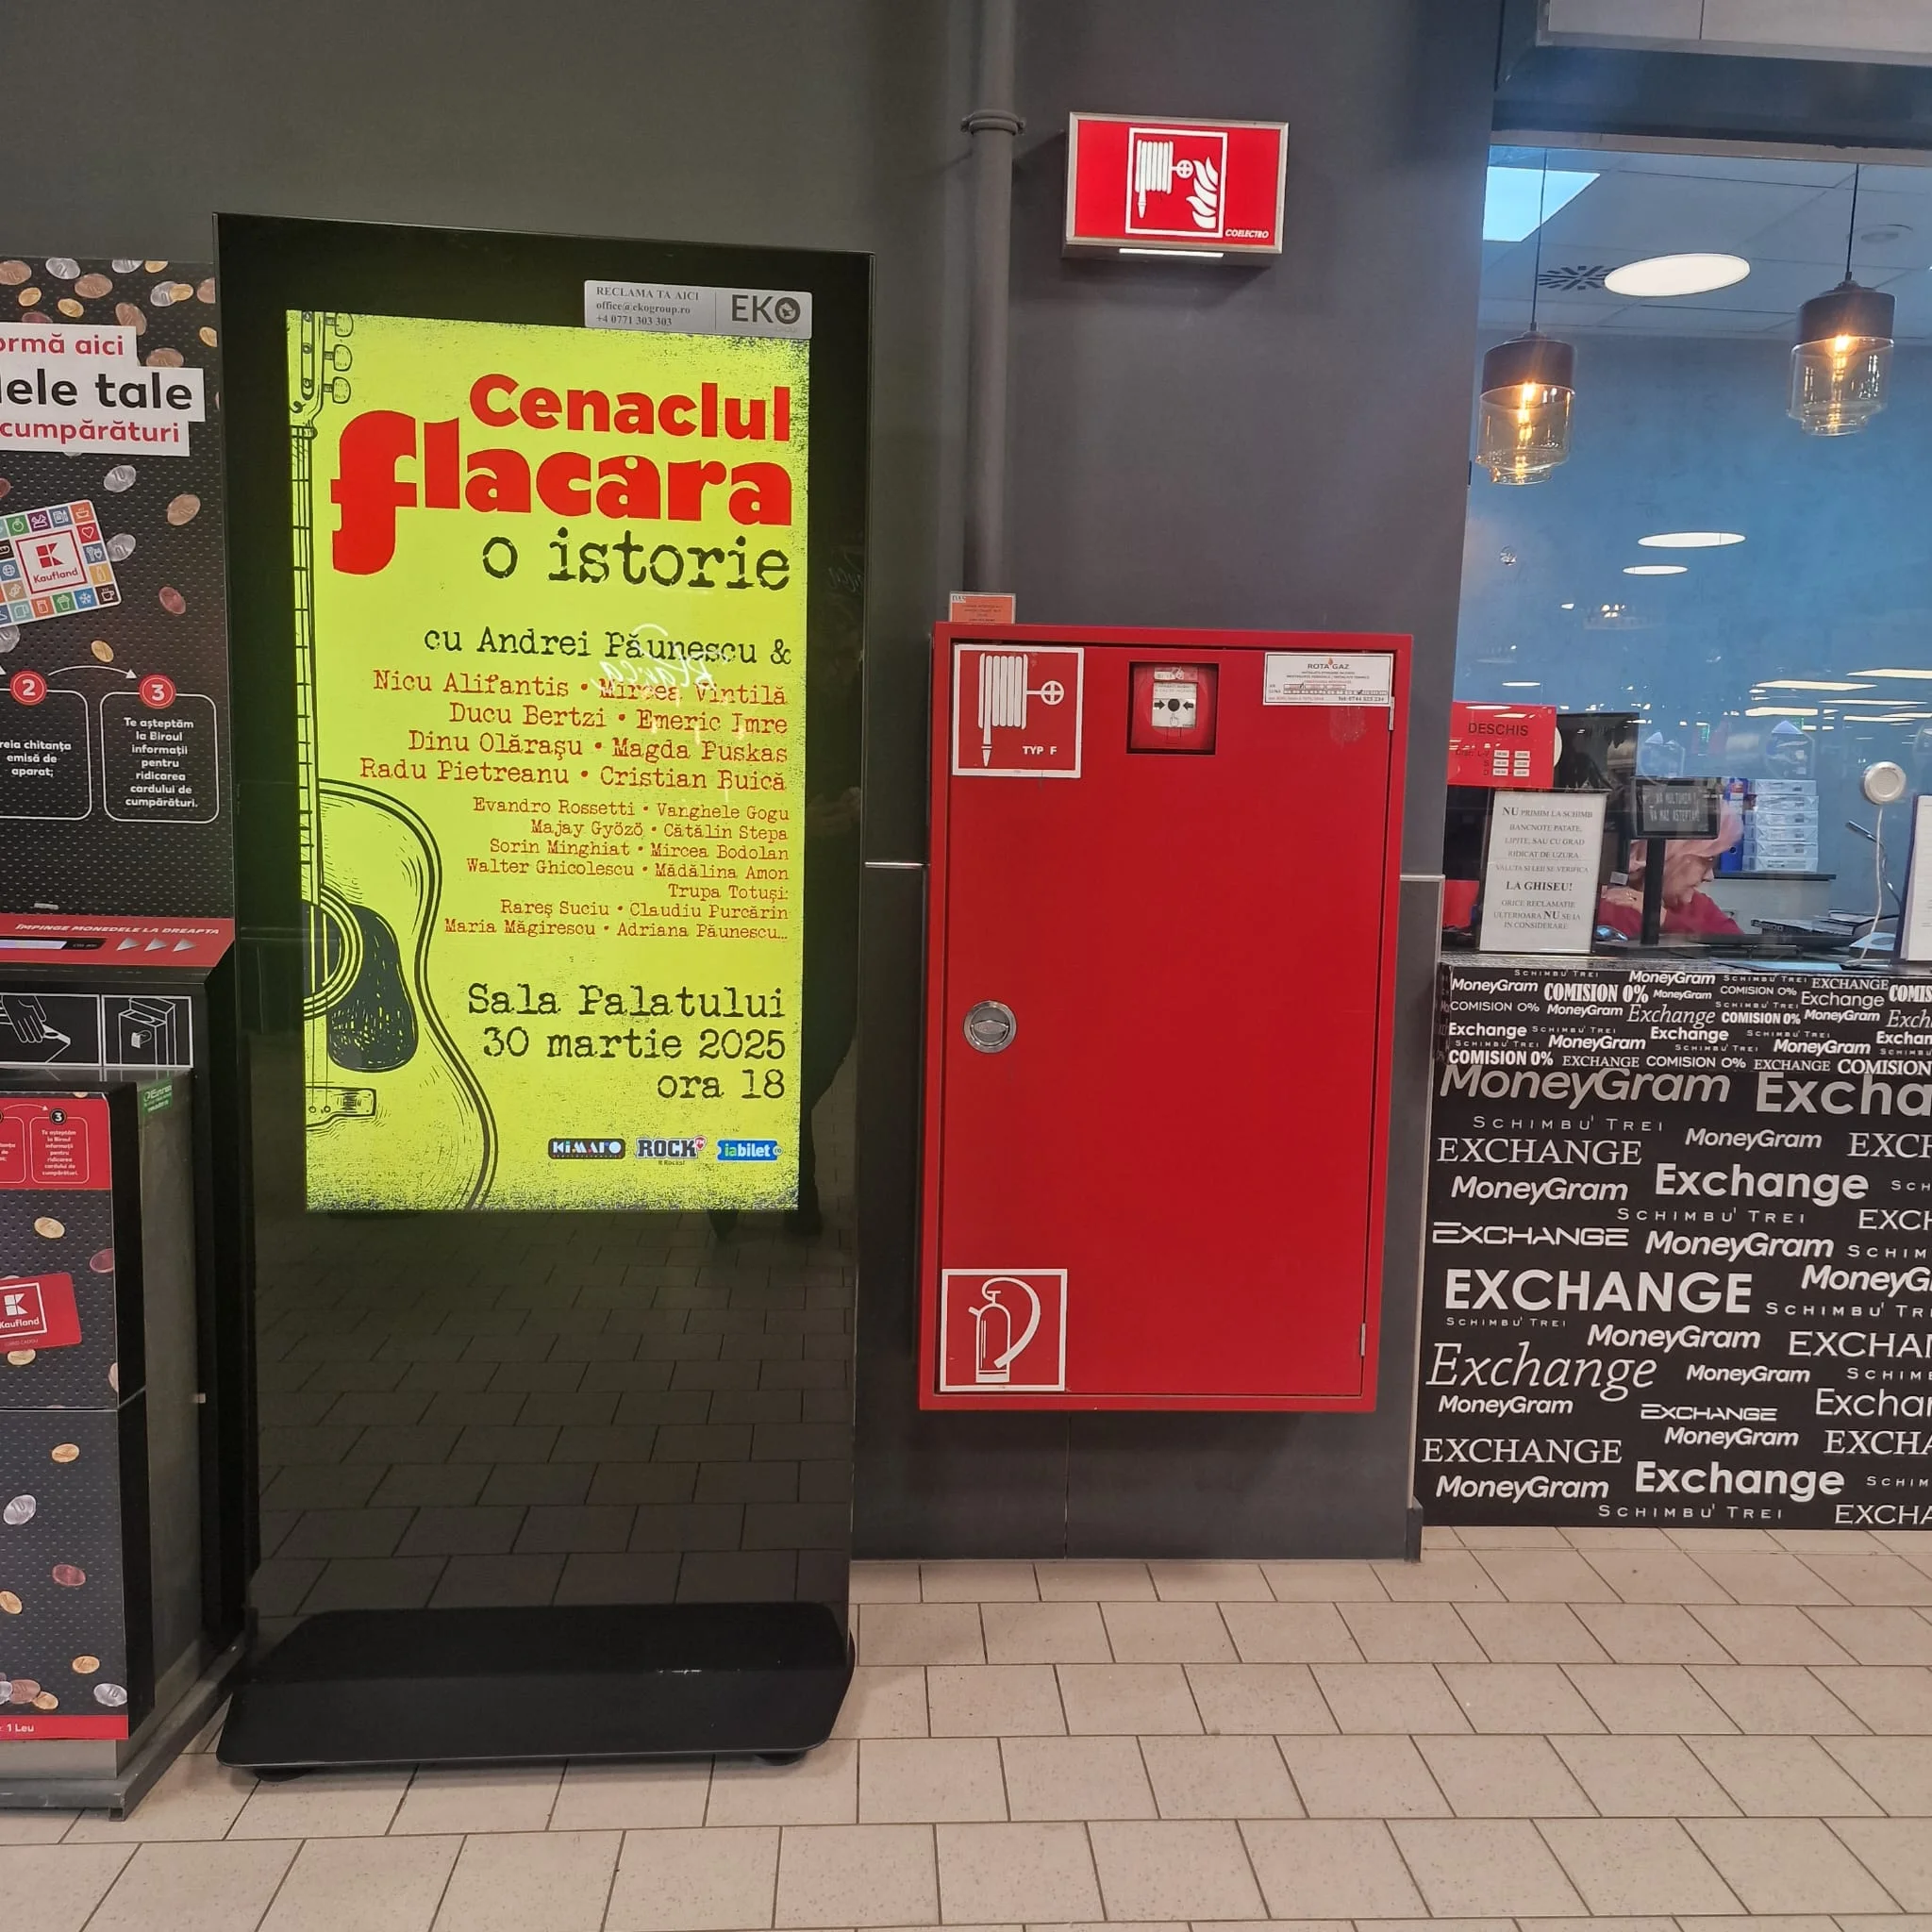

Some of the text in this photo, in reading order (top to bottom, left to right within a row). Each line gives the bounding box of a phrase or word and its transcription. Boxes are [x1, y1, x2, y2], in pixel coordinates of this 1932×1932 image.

[1224, 228, 1269, 239] COELECTRO
[596, 286, 699, 301] RECLAMA TA AICI
[596, 302, 691, 315] office@ekogroup.ro
[731, 293, 801, 325] EKO
[610, 316, 632, 325] 0771
[636, 317, 653, 326] 303
[656, 318, 673, 326] 303
[75, 335, 124, 356] aici
[0, 368, 192, 409] ele tale
[470, 374, 791, 441] Cenaclul
[0, 419, 179, 444] cumpărături
[330, 409, 792, 575] flacara
[482, 536, 518, 578] o
[548, 526, 791, 590] istorie
[33, 567, 78, 584] Kaufland
[424, 626, 791, 664] cu Andrei Păunescu &
[22, 678, 36, 696] 2
[151, 684, 165, 701] 3
[373, 669, 787, 705] Nicu Alifantis Mircea Vintilă
[124, 717, 194, 731] Te așteptăm
[449, 702, 788, 734] Ducu Bertzi Emeric Imre
[136, 731, 183, 742] la Biroul
[1468, 723, 1528, 737] DESCHIS
[24, 740, 72, 752] chitanța
[132, 744, 188, 757] informații
[408, 729, 788, 762] Dinu Olărașu Magda Puskas
[1023, 745, 1058, 756] TYP F
[7, 753, 58, 763] emisă de
[142, 758, 180, 771] pentru
[11, 767, 54, 778] aparat;
[136, 772, 186, 783] ridicarea
[360, 757, 786, 791] Radu Pietreanu Cristian Buică
[130, 785, 192, 796] cardului de
[125, 797, 199, 810] cumpărături.
[473, 797, 790, 822] Evandro Rossetti Vanghele Gogu
[1502, 807, 1520, 816] NU
[1521, 809, 1550, 818] PRIMIM
[1562, 810, 1593, 819] SCHIMB
[531, 819, 584, 837] Majay
[663, 824, 732, 840] Cătălin
[739, 826, 788, 843] Stepa
[490, 839, 789, 860] Sorin Minghiat Mircea Bodolan
[467, 858, 789, 880] Walter Ghicolescu Mădălina Amon
[1557, 865, 1590, 874] VERIFICA
[668, 883, 721, 901] Trupa
[1506, 881, 1574, 891] LA GHISEU!
[500, 899, 789, 920] Rareș Suciu Claudiu Purcărin
[1543, 910, 1561, 921] NU
[71, 925, 141, 934] MONEDELE
[444, 919, 497, 933] Maria
[504, 920, 595, 937] Măgirescu
[616, 922, 688, 937] Adriana
[1451, 978, 1539, 994] MoneyGram
[1544, 982, 1649, 1004] COMISION 0%
[468, 982, 786, 1018] Sala Palatului
[1721, 1011, 1801, 1025] COMISION 0%
[1448, 1022, 1527, 1040] Exchange
[482, 1025, 786, 1059] 30 martie 2025
[1754, 1058, 1831, 1072] EXCHANGE
[657, 1068, 786, 1099] ora 18
[1440, 1064, 1730, 1110] MoneyGram
[1685, 1127, 1822, 1152] MoneyGram
[638, 1140, 697, 1158] ROCK
[724, 1142, 771, 1158] iabilet
[1437, 1136, 1642, 1166] EXCHANGE
[1655, 1162, 1869, 1207] Exchange
[1748, 1209, 1805, 1224] TREI
[1645, 1230, 1834, 1262] MoneyGram
[1445, 1268, 1752, 1314] EXCHANGE
[1587, 1324, 1761, 1354] MoneyGram
[1425, 1341, 1657, 1402] Exchange
[1422, 1438, 1623, 1464] EXCHANGE
[1635, 1460, 1845, 1502] Exchange
[7, 1724, 35, 1733] 1 Leu
